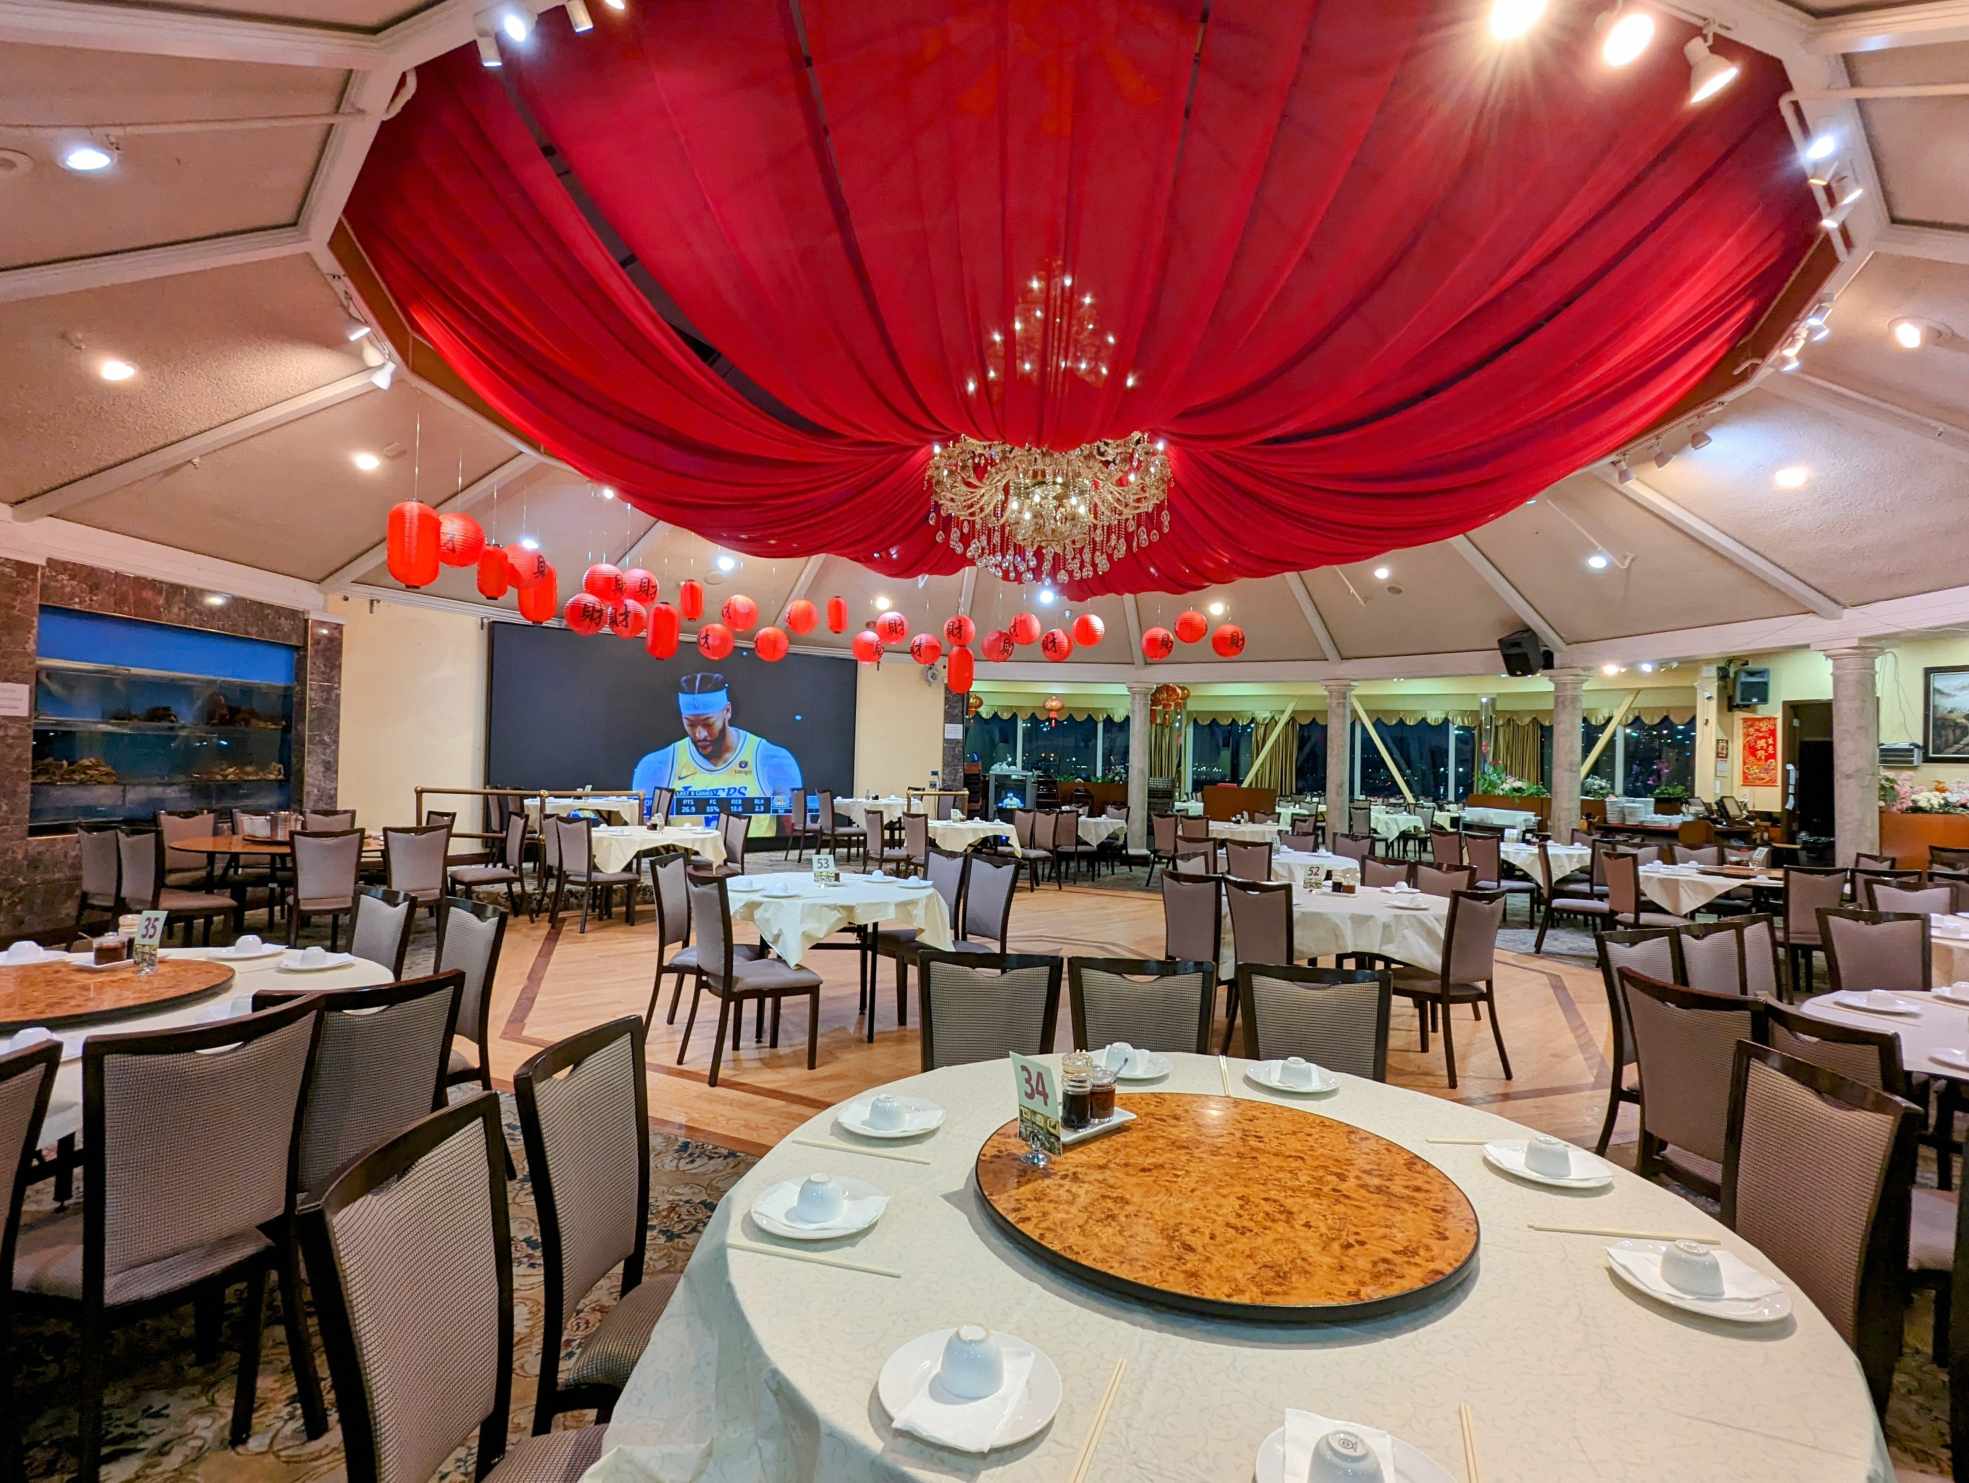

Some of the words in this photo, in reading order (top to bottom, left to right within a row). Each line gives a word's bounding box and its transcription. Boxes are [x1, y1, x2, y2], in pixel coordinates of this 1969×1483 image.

[817, 858, 830, 869] 53
[1307, 866, 1320, 876] 52
[141, 916, 160, 939] 35
[1020, 1064, 1049, 1107] 34
